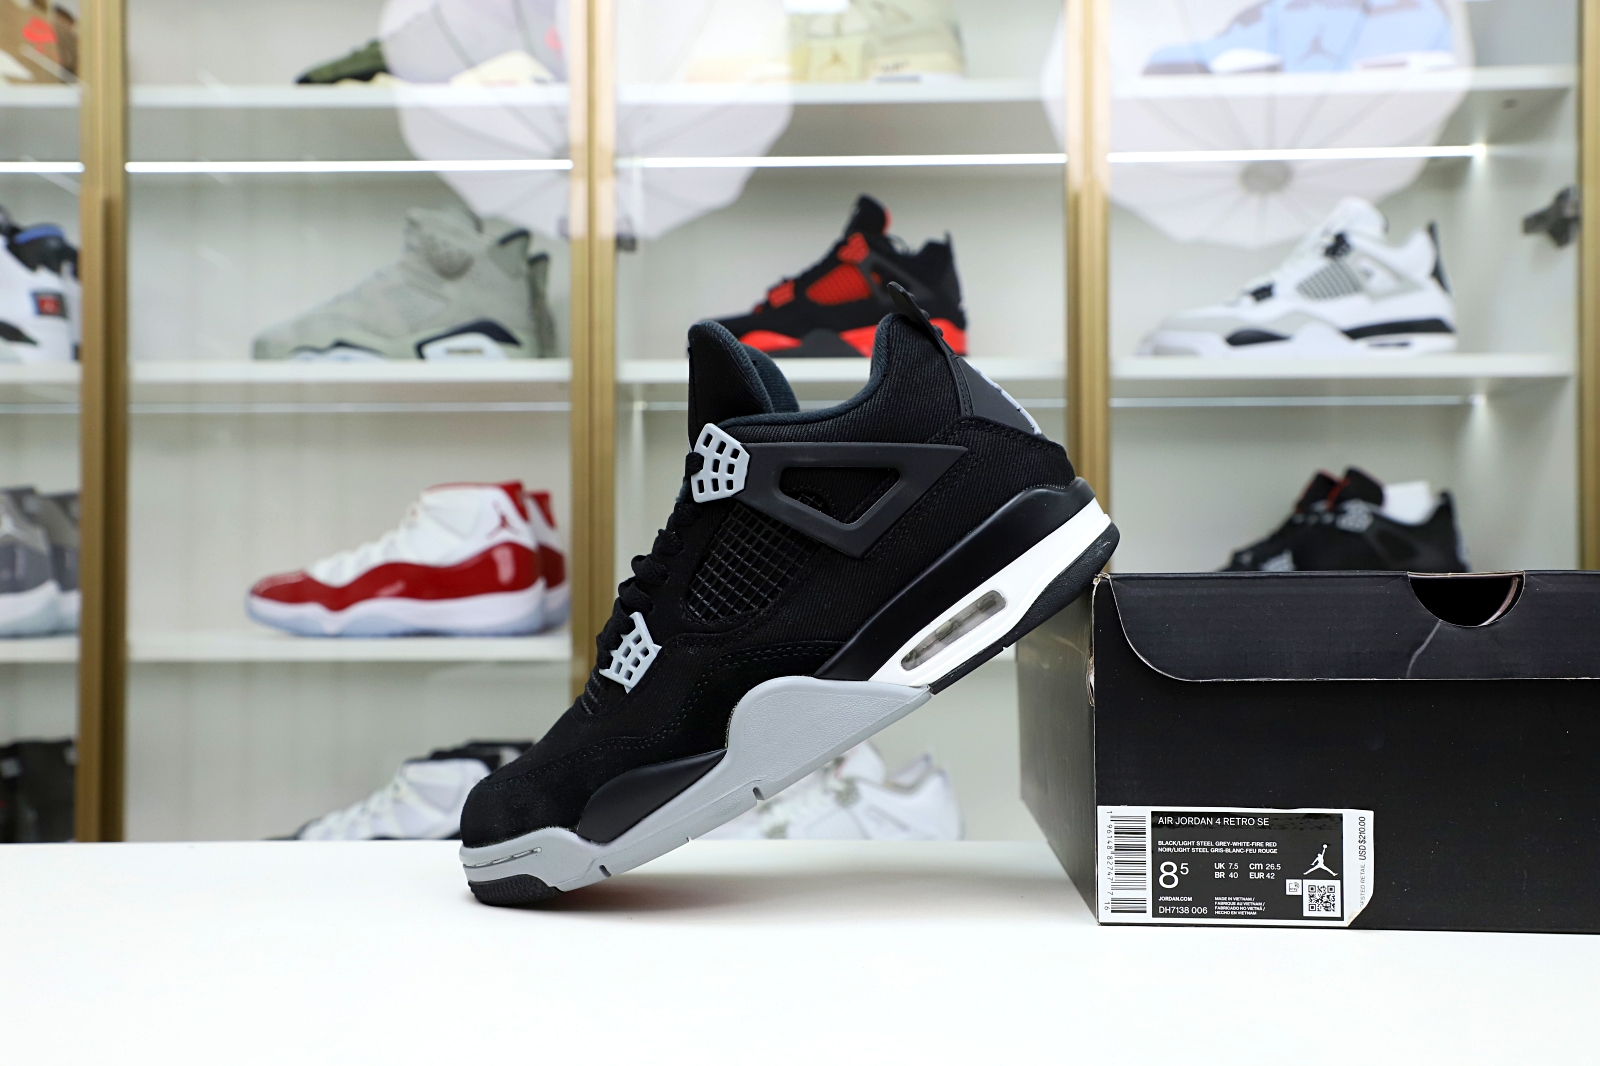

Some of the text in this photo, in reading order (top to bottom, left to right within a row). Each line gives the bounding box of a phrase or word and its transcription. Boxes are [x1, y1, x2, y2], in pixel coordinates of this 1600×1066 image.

[1158, 817, 1270, 826] AIR JORDAN 4 RETRO SE
[1358, 816, 1366, 845] $210.00
[1358, 845, 1366, 861] USD
[1158, 906, 1208, 914] DH7138 006
